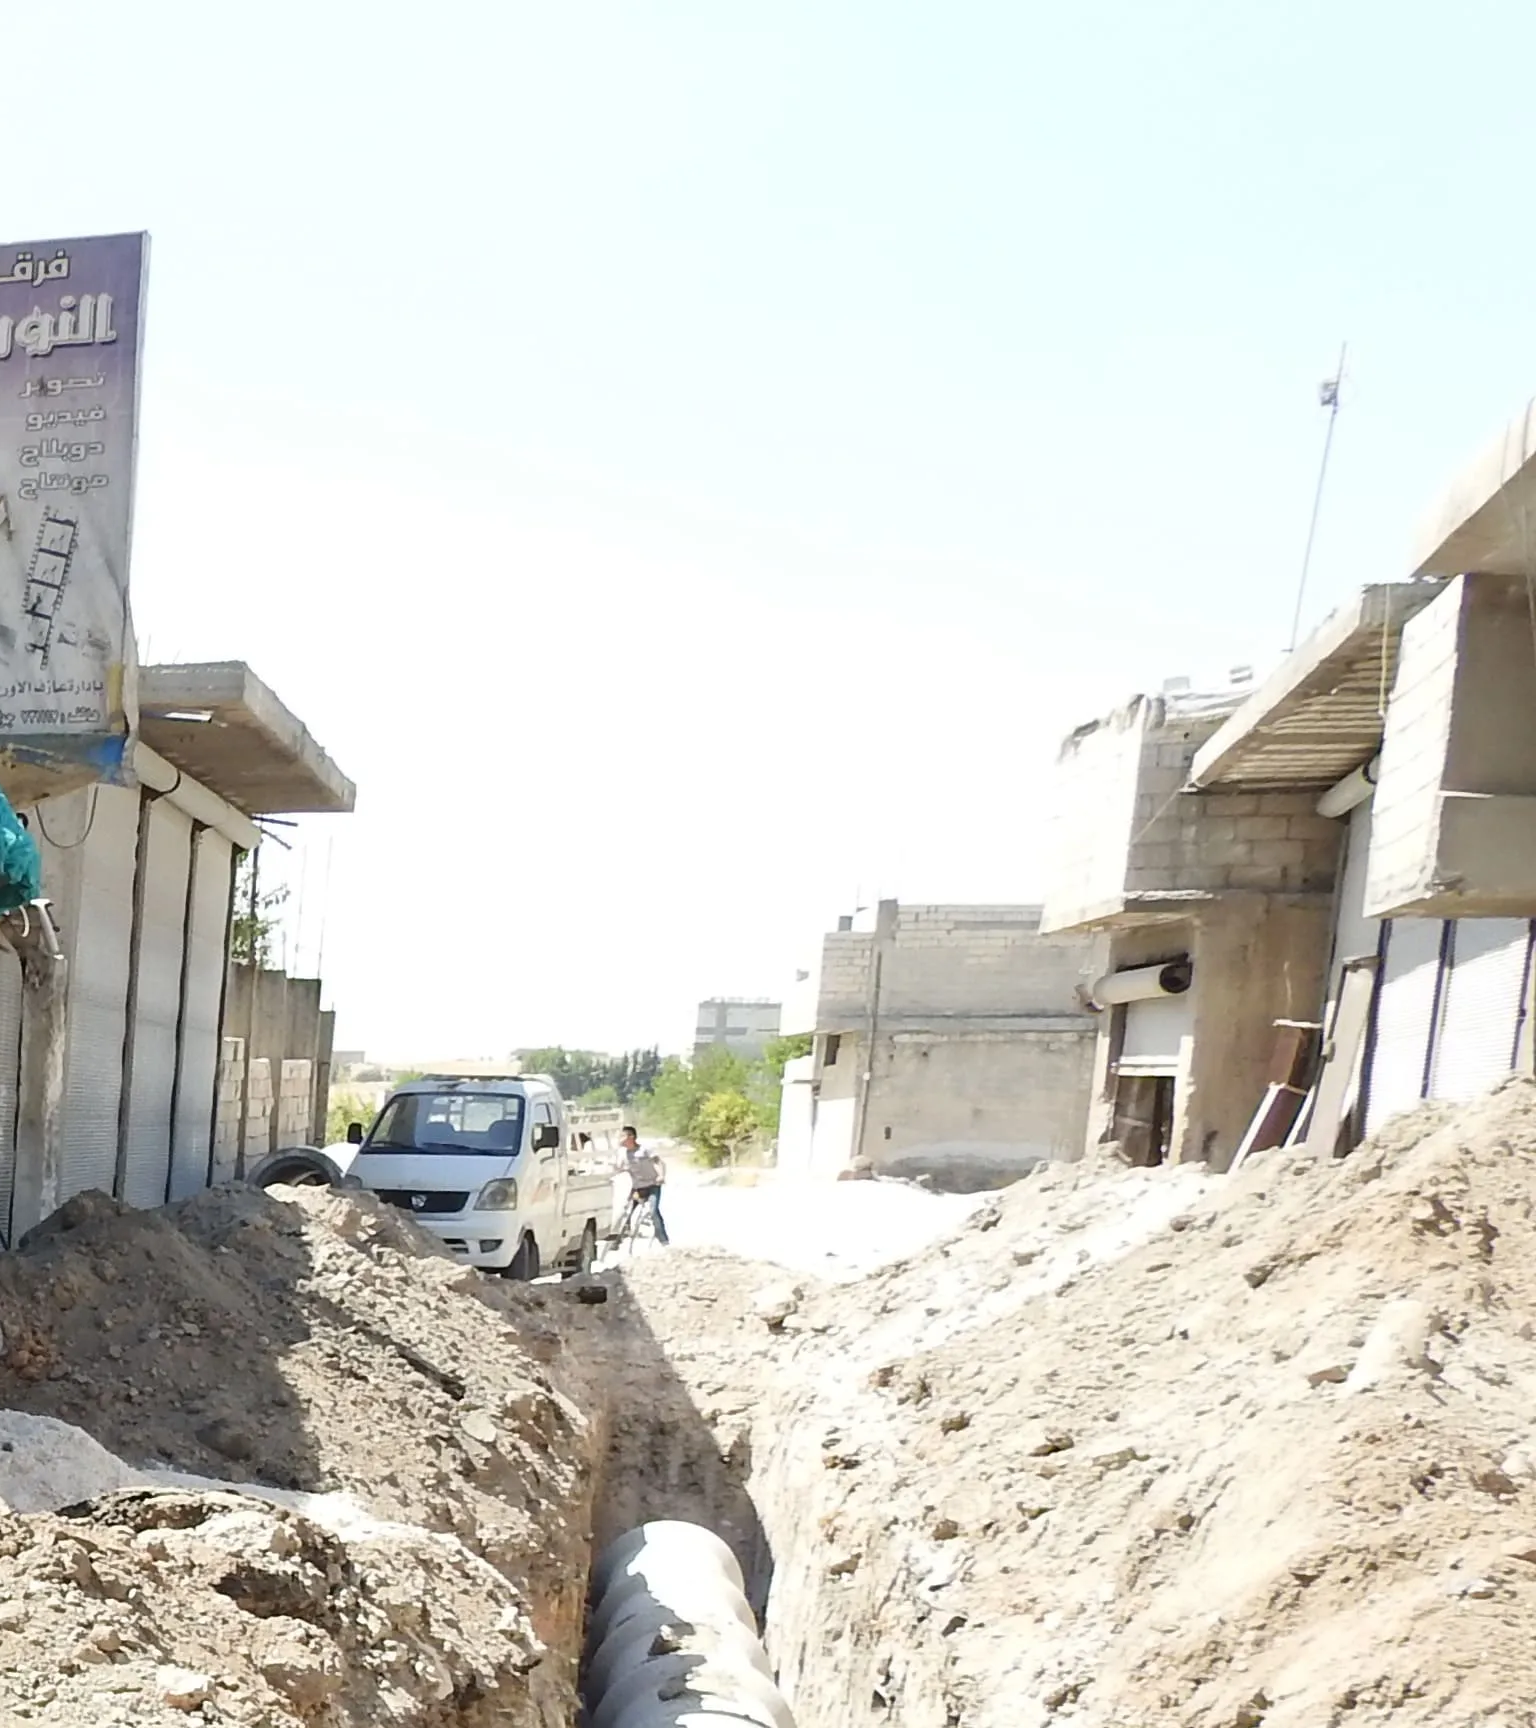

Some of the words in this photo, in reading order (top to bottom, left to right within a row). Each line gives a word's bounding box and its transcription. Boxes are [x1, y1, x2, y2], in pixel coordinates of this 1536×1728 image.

[19, 371, 107, 398] تصوير
[26, 404, 106, 431] فيديو
[20, 438, 105, 467] دوبلاج
[18, 472, 109, 500] مونتاج
